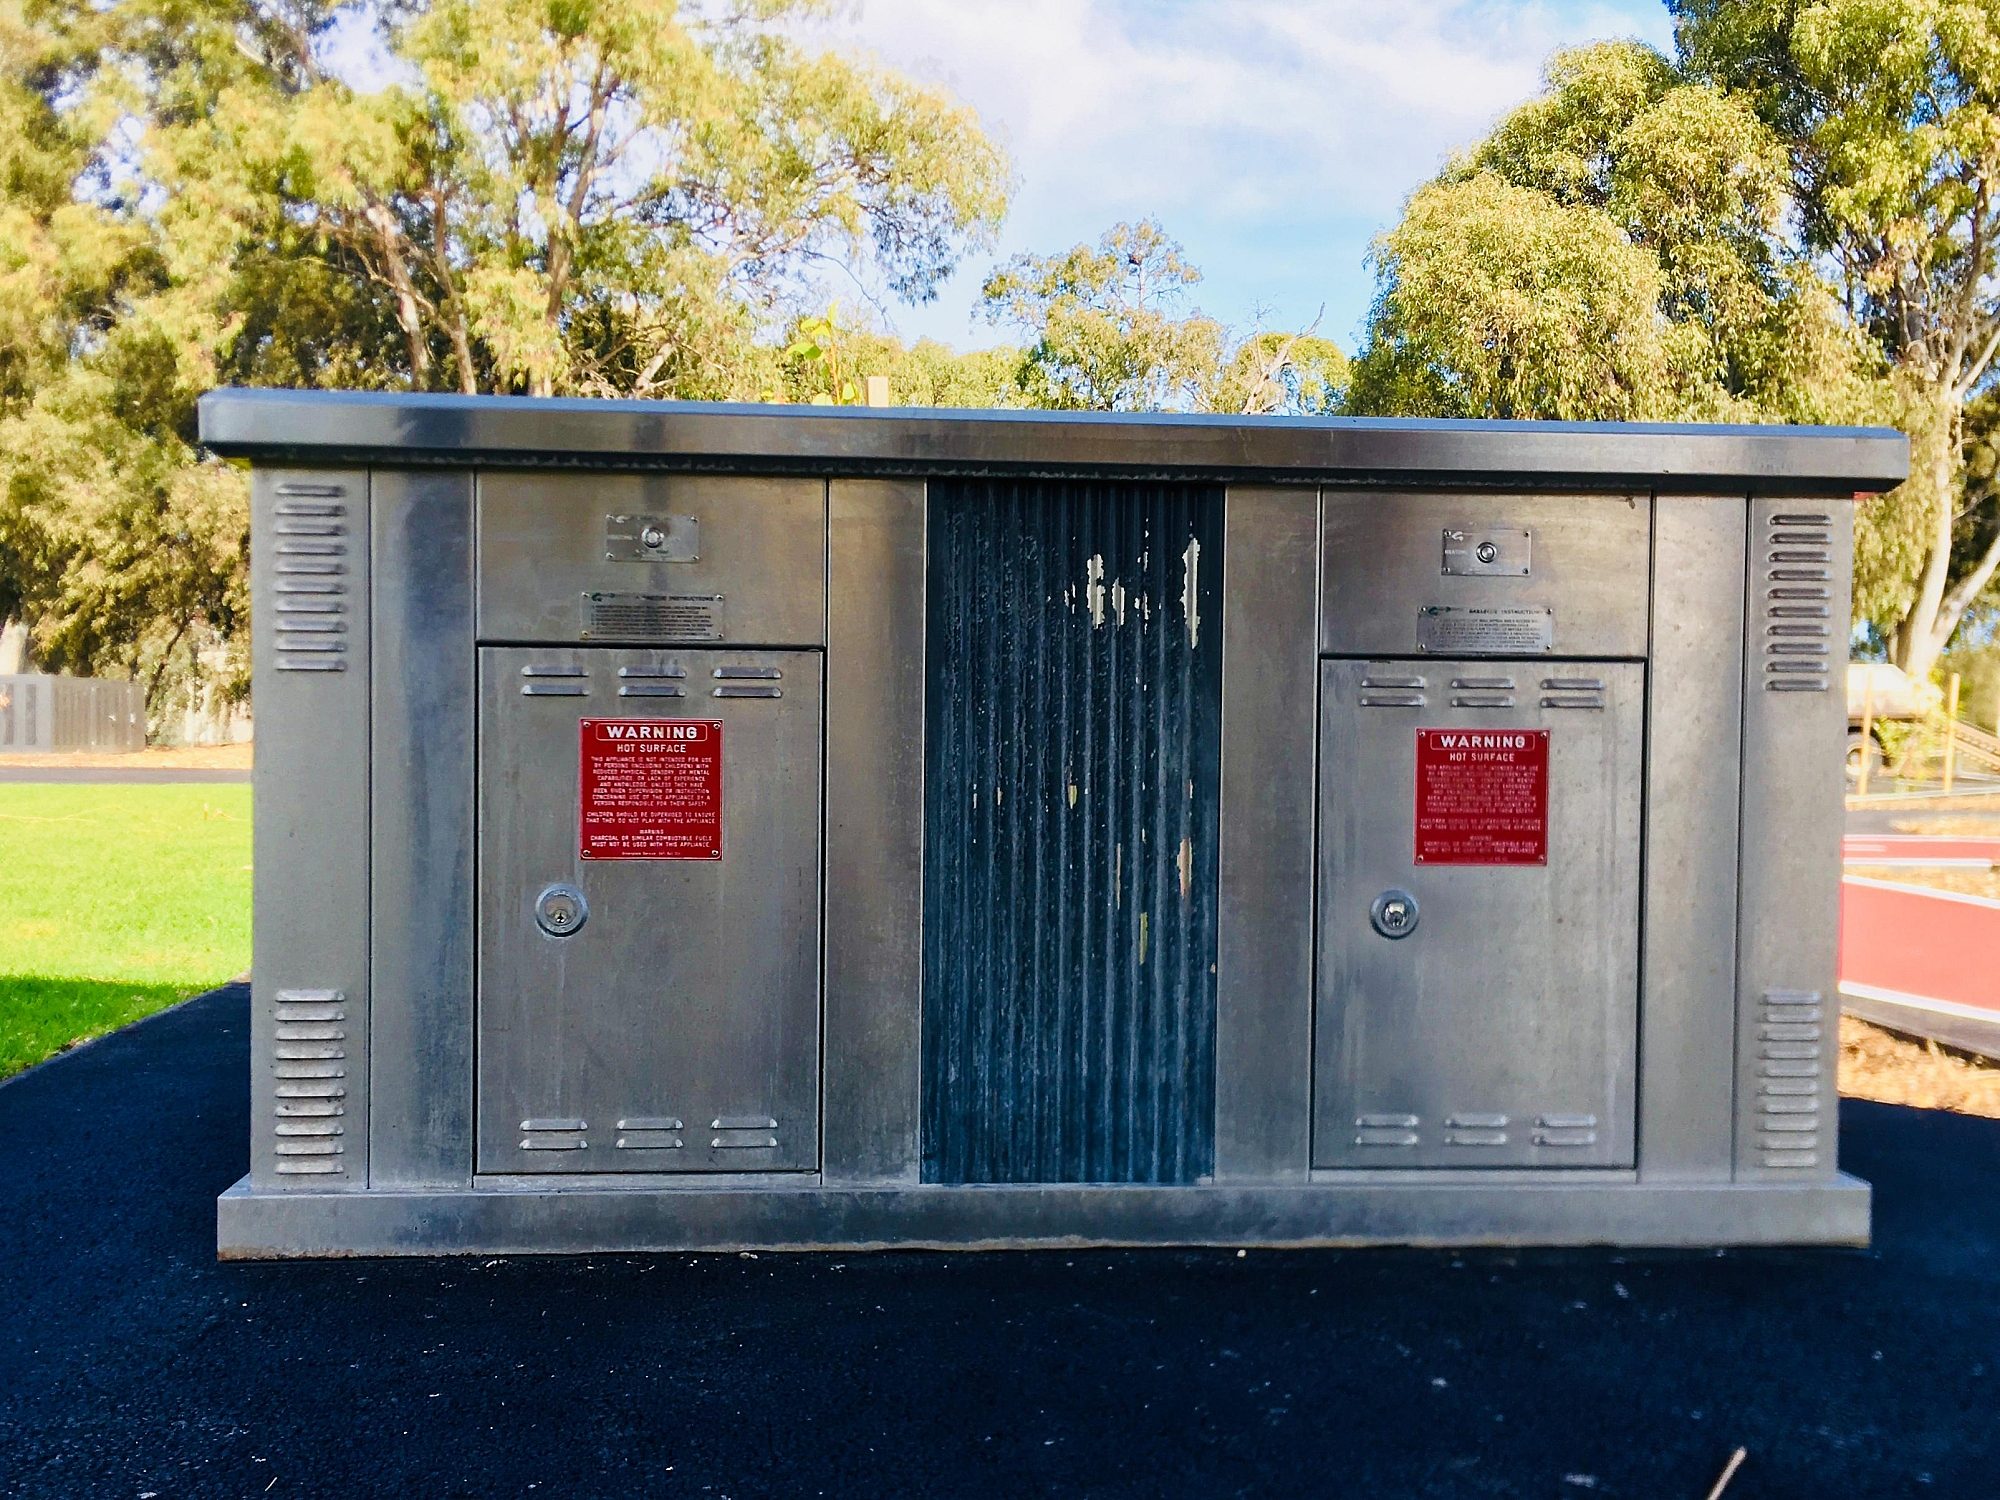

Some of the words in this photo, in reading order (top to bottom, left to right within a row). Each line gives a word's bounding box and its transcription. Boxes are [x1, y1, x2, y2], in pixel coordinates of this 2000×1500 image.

[607, 726, 697, 738] WARNING
[1441, 736, 1525, 748] WARNING
[617, 744, 635, 752] HOT
[640, 744, 686, 752] SURFACE
[1450, 753, 1466, 761] HOT
[1472, 753, 1515, 761] SURFACE
